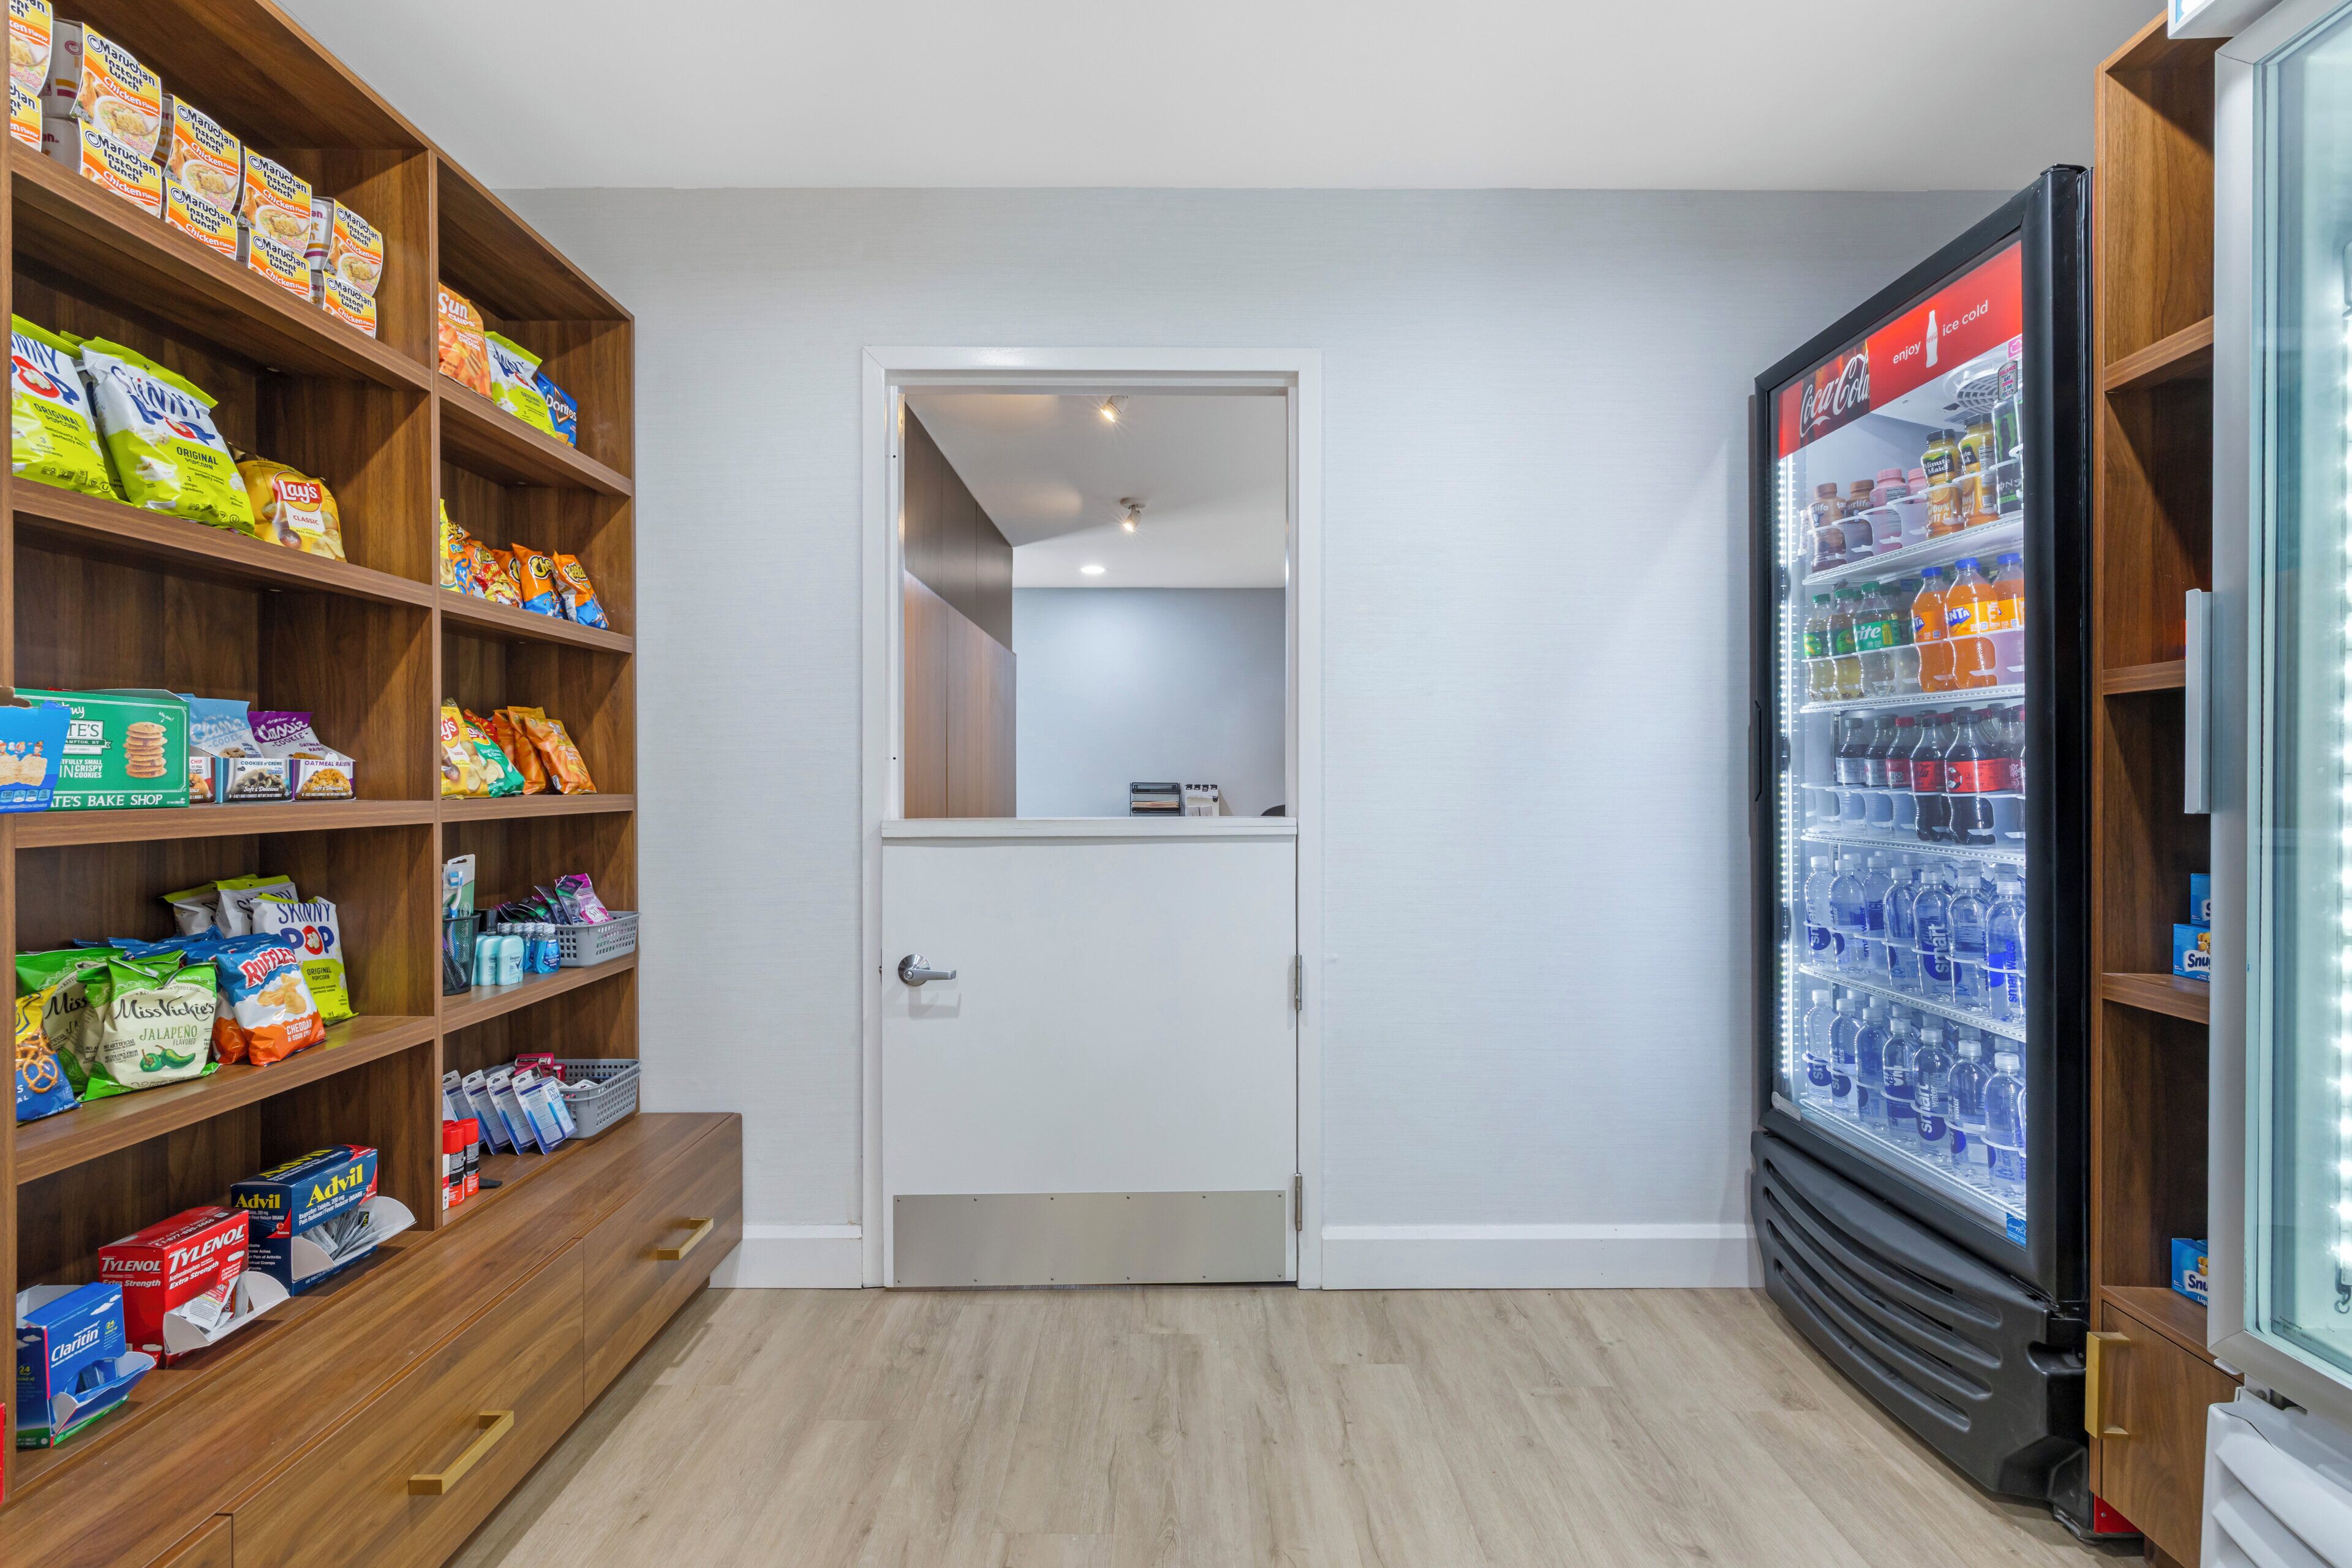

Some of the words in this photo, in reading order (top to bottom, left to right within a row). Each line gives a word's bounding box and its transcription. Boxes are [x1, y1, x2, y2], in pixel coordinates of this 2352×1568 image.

[99, 39, 156, 88] Maruchan
[105, 55, 143, 87] Instant
[109, 67, 139, 92] Lunch
[104, 77, 142, 105] Chicken
[142, 102, 159, 113] Flavor
[189, 108, 236, 149] Maruchan
[192, 123, 224, 149] Instant
[196, 133, 221, 155] Lunch
[98, 136, 157, 177] Maruchan
[104, 149, 143, 178] Instant
[191, 143, 224, 167] Chicken
[224, 163, 238, 172] Flavor
[108, 160, 139, 184] Lunch
[260, 158, 307, 194] Maruchan
[264, 170, 296, 195] Instant
[104, 171, 142, 197] Chicken
[143, 192, 159, 202] Flavor
[267, 179, 292, 200] Lunch
[182, 191, 233, 227] Maruchan
[263, 189, 295, 212] Chicken
[186, 204, 221, 228] Instant
[190, 214, 217, 233] Lunch
[345, 210, 380, 241] Maruchan
[186, 224, 219, 246] Chicken
[220, 241, 235, 250] Flavor
[347, 222, 371, 243] Instant
[349, 230, 369, 247] Lunch
[263, 238, 306, 270] Maruchan
[346, 238, 370, 258] Chicken
[266, 251, 296, 271] Instant
[270, 259, 293, 277] Lunch
[265, 268, 295, 288] Chicken
[336, 280, 372, 306] Maruchan
[338, 290, 364, 309] Instant
[338, 307, 363, 324] Chicken
[341, 298, 361, 314] Lunch
[439, 292, 468, 319] Sun
[448, 313, 475, 327] CHIPS
[1893, 341, 1921, 365] enjoy
[1942, 321, 1959, 336] ice
[1962, 300, 1989, 325] cold
[1999, 364, 2016, 376] BALANCE
[34, 403, 81, 428] ORIGINAL
[545, 393, 577, 421] Doritos
[45, 415, 80, 432] POPCORN
[176, 447, 219, 466] ORIGINAL
[184, 458, 214, 470] POPCORN
[1924, 459, 1951, 469] Minute
[1928, 464, 1948, 475] Maid
[278, 480, 318, 504] Lay's
[293, 515, 319, 526] CLASSIC
[1946, 607, 1970, 622] NTA
[275, 732, 305, 747] COOKIE
[87, 795, 126, 807] BAKE
[130, 794, 163, 806] SHOP
[278, 903, 330, 924] SKINNY
[281, 925, 335, 956] POP
[1928, 924, 1950, 974] smart
[240, 948, 298, 987] RUFFLES
[307, 967, 332, 975] ORIGINAL
[45, 992, 89, 1019] Miss
[140, 1024, 198, 1041] JALAPEÑO
[287, 1019, 312, 1035] CHEDDAR
[111, 1039, 134, 1049] ARTIFICIAL
[1930, 1085, 1939, 1107] water
[306, 1164, 363, 1208] Advil
[235, 1193, 281, 1208] Advil
[299, 1207, 317, 1219] Ibuprofen
[317, 1201, 331, 1211] Tablets,
[299, 1218, 308, 1226] Pain
[308, 1206, 335, 1220] Reliever/Fever
[334, 1199, 350, 1208] Reducer
[148, 1237, 164, 1246] How
[168, 1225, 245, 1275] TYLENOL
[102, 1257, 161, 1272] TYLENOL
[169, 1262, 200, 1283] Acetaminophen
[169, 1275, 189, 1290] Extra
[190, 1261, 219, 1280] Strength
[124, 1280, 161, 1289] Strength
[106, 1320, 115, 1330] 24
[51, 1329, 99, 1362] Claritin
